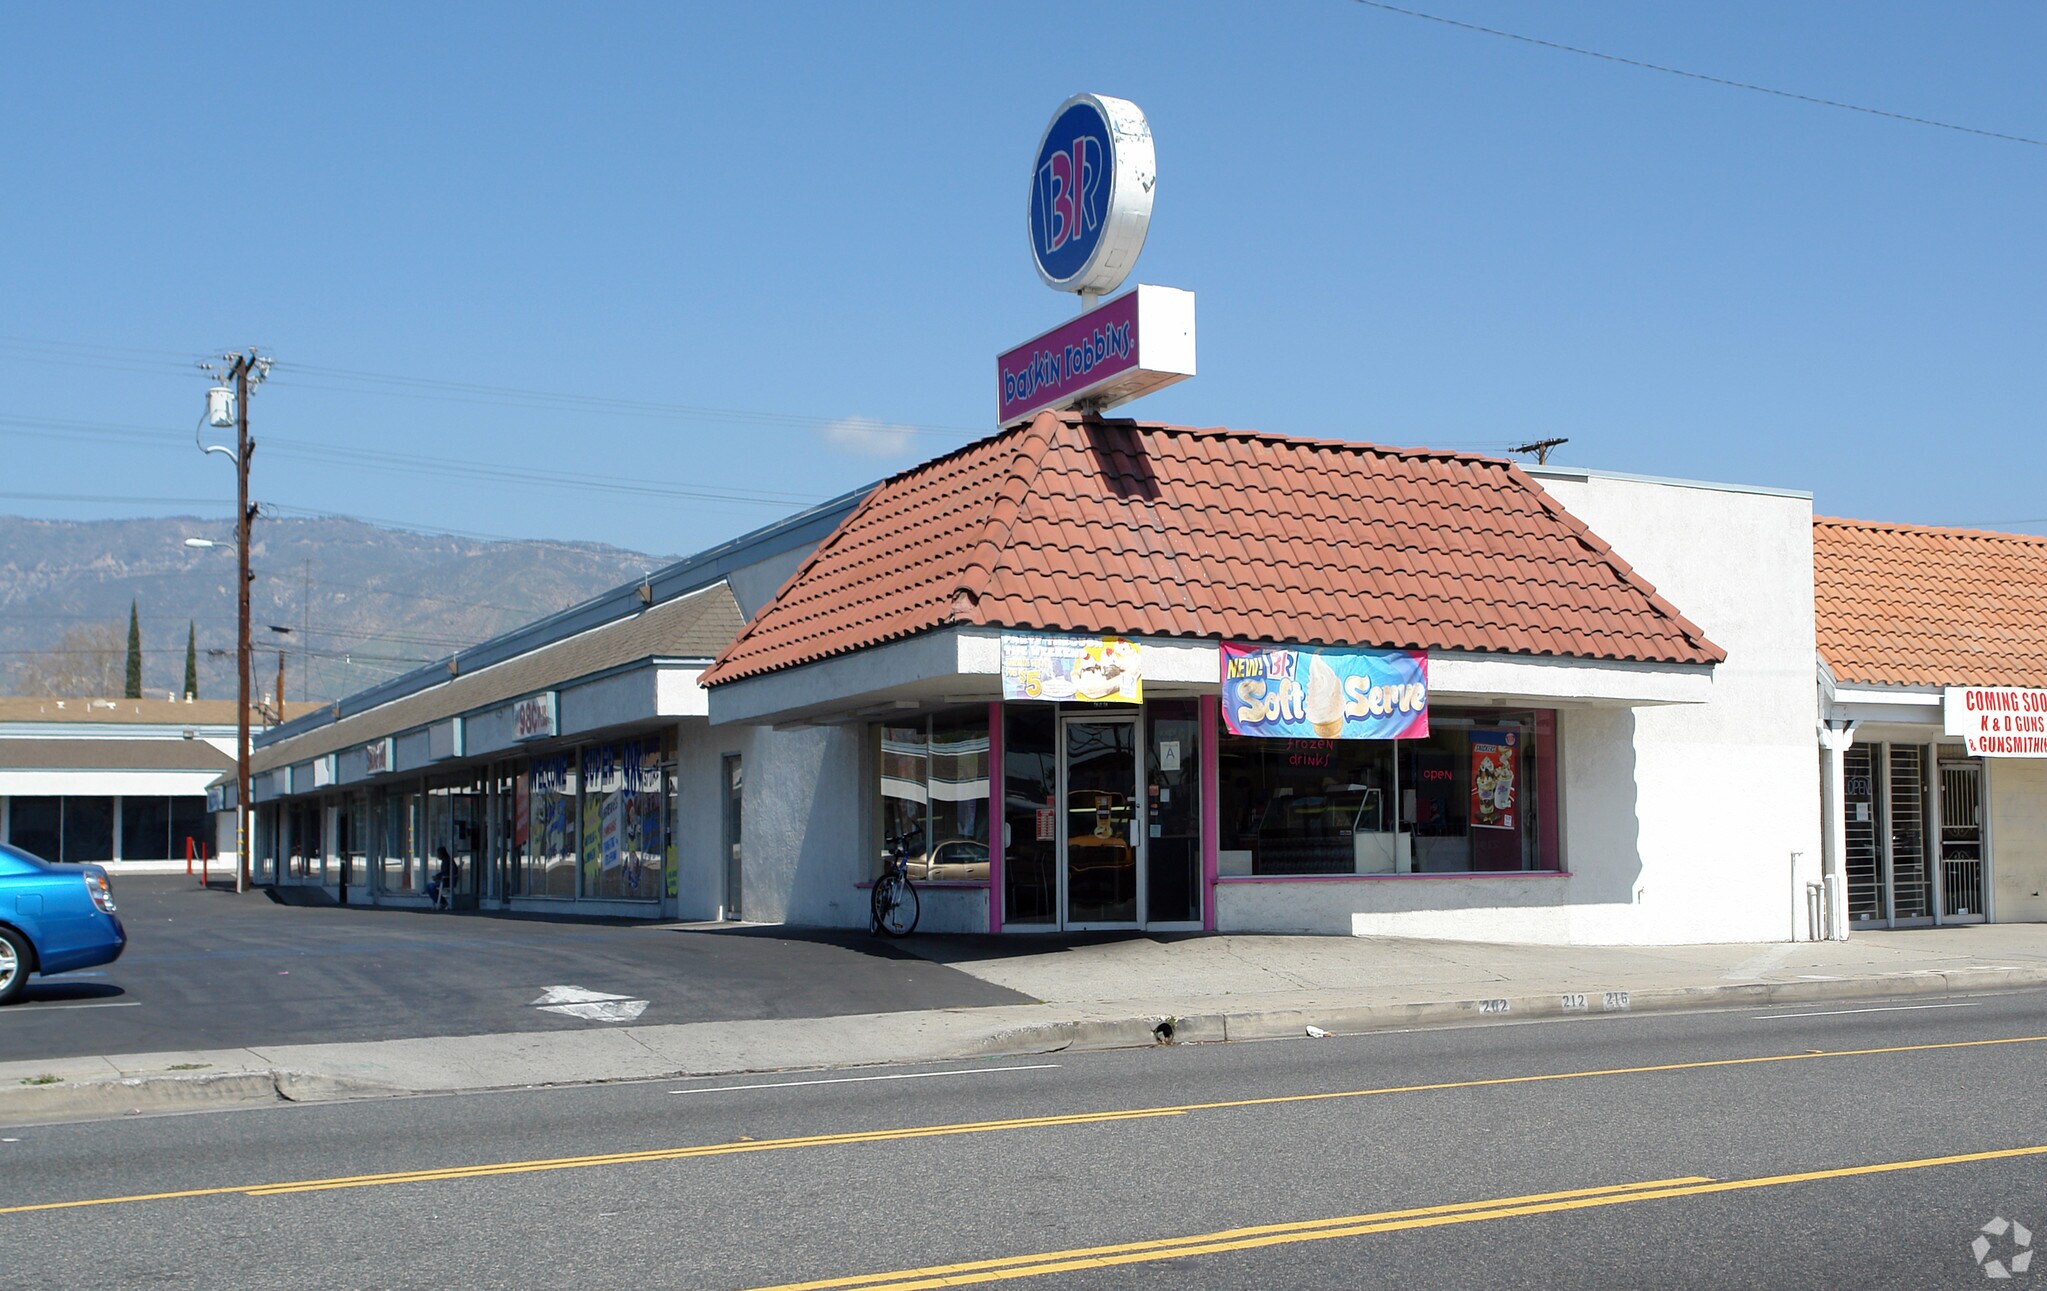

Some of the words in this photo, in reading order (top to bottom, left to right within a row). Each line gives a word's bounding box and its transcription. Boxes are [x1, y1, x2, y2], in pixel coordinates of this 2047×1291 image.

[1039, 136, 1102, 255] BR
[1004, 351, 1061, 405] baskin
[1227, 656, 1264, 680] NEW!
[1019, 670, 1042, 698] $5
[1237, 677, 1306, 724] Soft
[1344, 675, 1427, 720] Serve
[1966, 690, 2019, 711] COMING
[1981, 715, 1989, 731] K
[1993, 718, 2000, 731] &
[2004, 716, 2011, 731] D
[2015, 716, 2045, 732] GUNS
[1166, 747, 1175, 759] A
[1286, 738, 1334, 751] frozen
[1969, 739, 1976, 751] &
[1289, 753, 1330, 767] drinks
[1423, 769, 1453, 781] open
[1562, 994, 1585, 1008] 212
